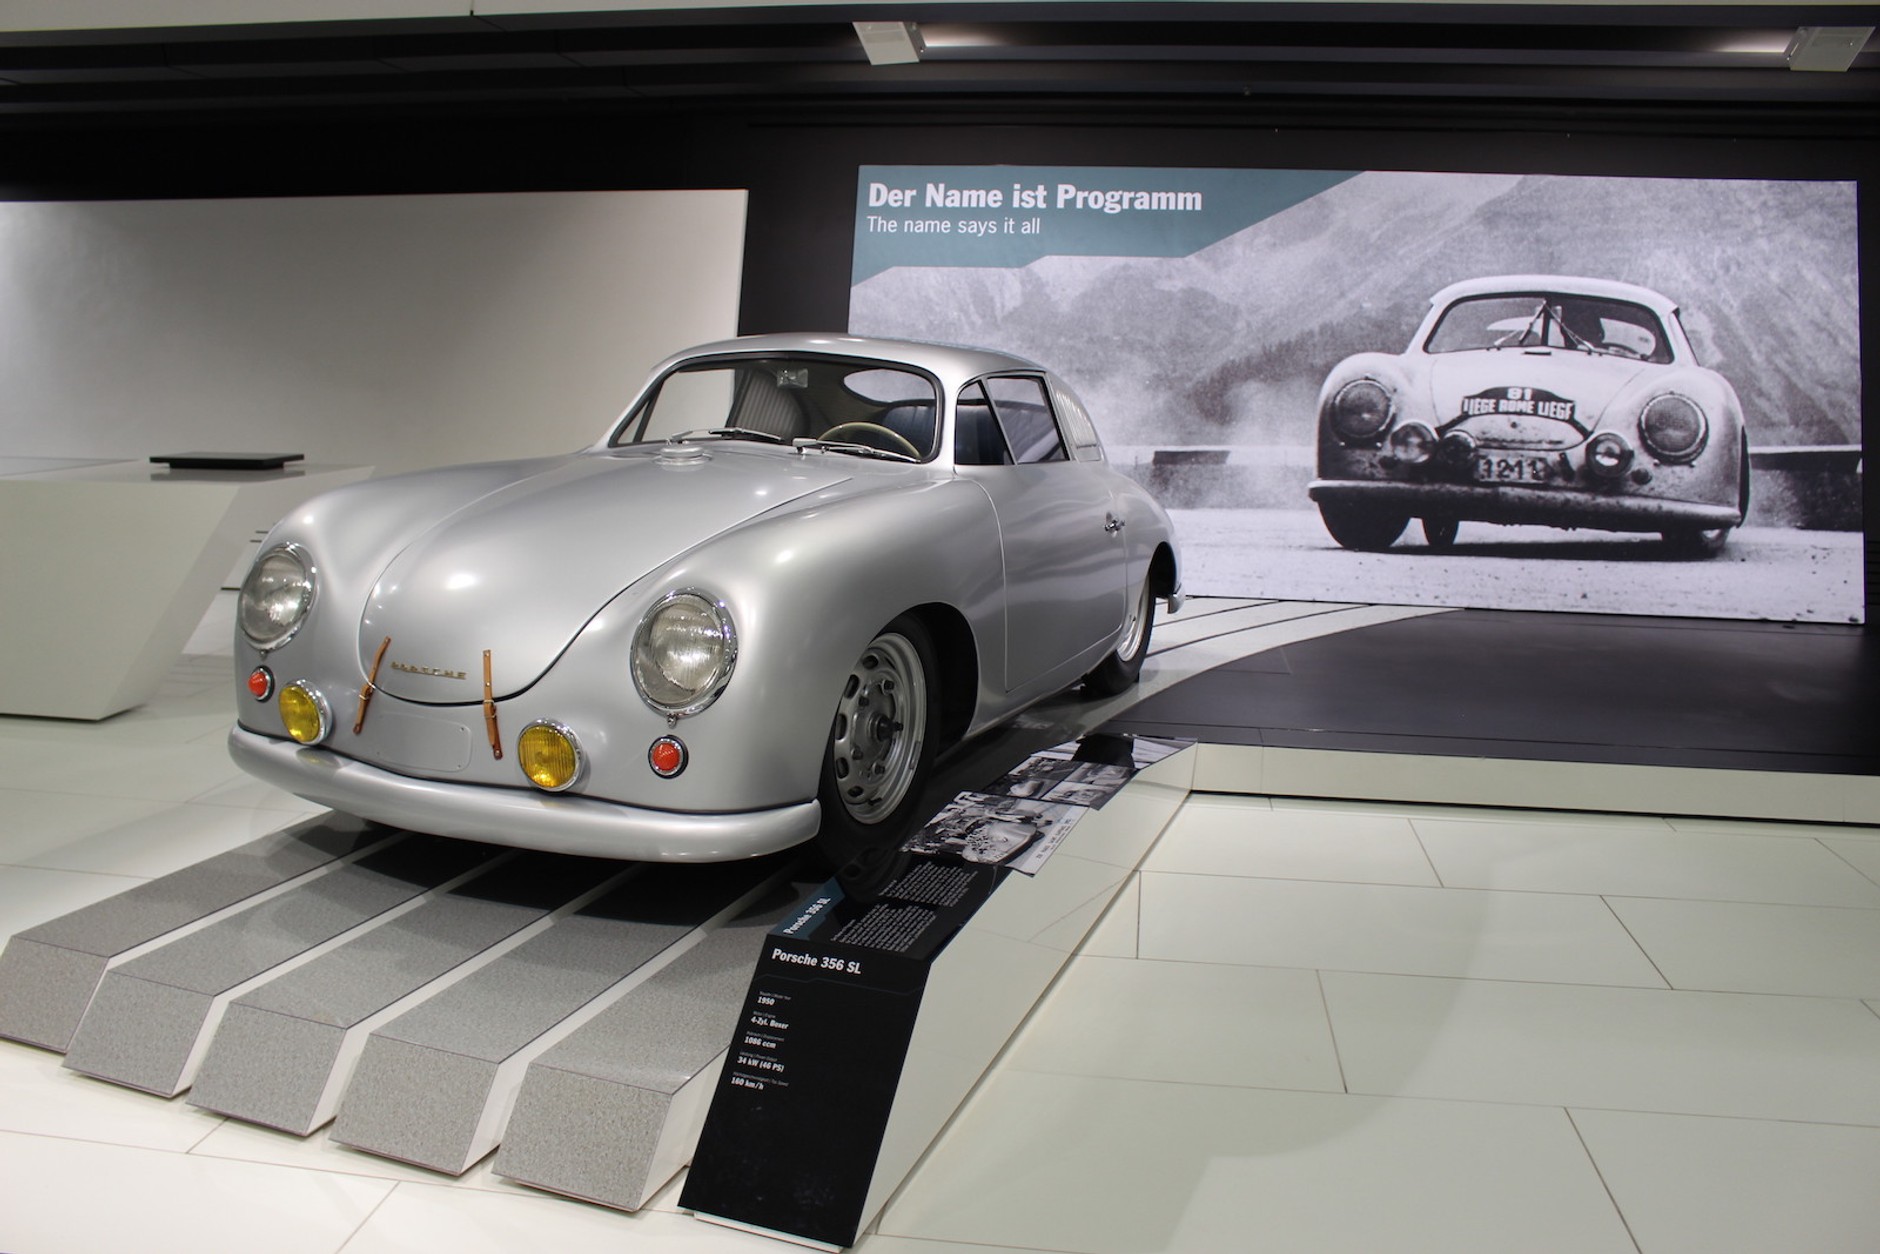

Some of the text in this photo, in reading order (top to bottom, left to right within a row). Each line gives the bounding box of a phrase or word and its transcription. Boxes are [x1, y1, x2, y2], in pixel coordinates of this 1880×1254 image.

[868, 182, 1203, 215] Der Name ist Programm
[867, 216, 1040, 237] The name says it all
[1499, 399, 1534, 414] ROME
[783, 914, 812, 934] Porsche
[805, 904, 823, 915] 356
[771, 948, 862, 975] Porsche 356 SL
[758, 997, 775, 1006] 1950
[770, 1020, 789, 1030] Boxer
[744, 1036, 762, 1046] 1086
[762, 1040, 777, 1049] ccm
[737, 1056, 747, 1064] 34
[748, 1057, 759, 1067] kW
[772, 1062, 785, 1073] PS)
[731, 1076, 744, 1087] 160
[744, 1079, 764, 1091] km/h
